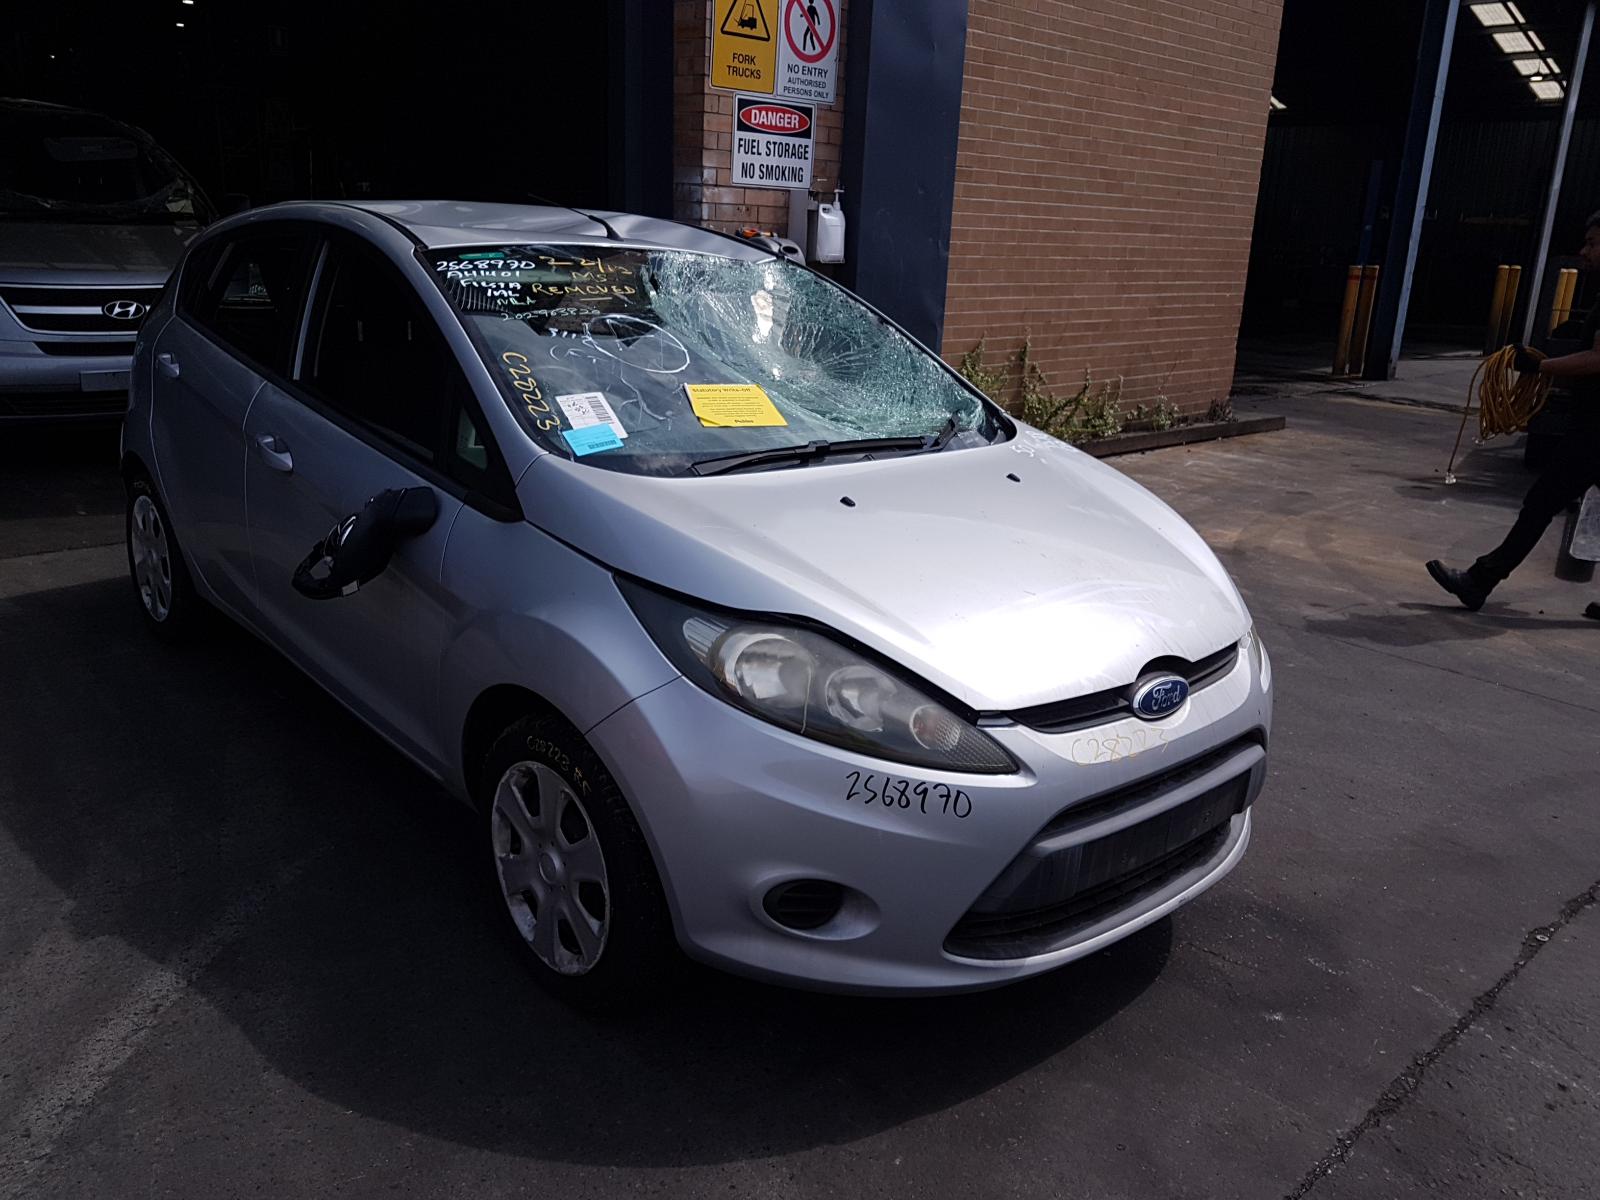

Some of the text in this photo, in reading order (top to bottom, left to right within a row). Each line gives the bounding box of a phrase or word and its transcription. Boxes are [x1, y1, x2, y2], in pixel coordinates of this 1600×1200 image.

[733, 53, 756, 65] FORK
[727, 65, 761, 79] TRUCKS
[787, 64, 829, 79] NO ENTRY
[788, 77, 827, 89] AUTHORISED
[783, 87, 829, 99] PERSONS ONLY
[751, 110, 800, 129] DANGER
[738, 138, 809, 160] FUEL STORAGE
[741, 162, 804, 183] NO SMOKING
[436, 259, 536, 272] 2568970
[531, 283, 636, 296] REMOVED
[502, 351, 560, 432] C28223
[1151, 682, 1181, 712] Ford
[845, 771, 973, 819] 2568970
